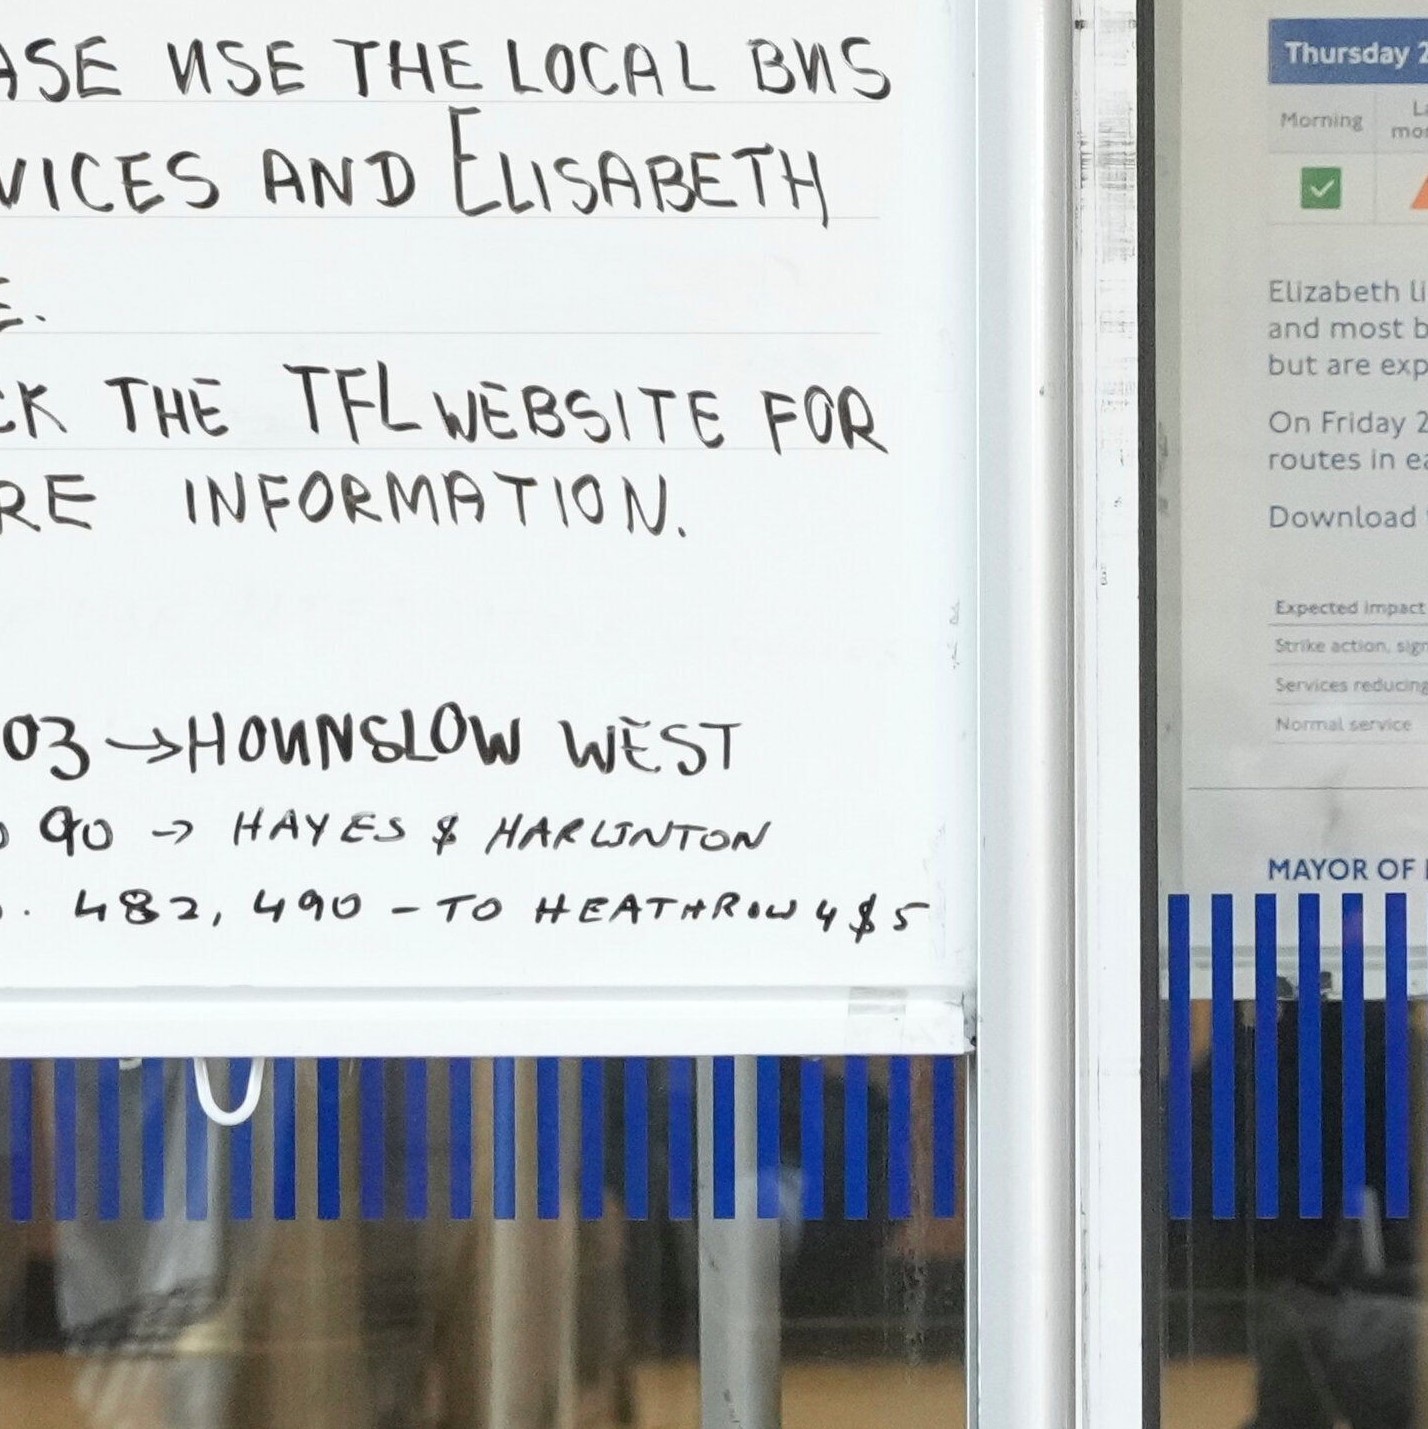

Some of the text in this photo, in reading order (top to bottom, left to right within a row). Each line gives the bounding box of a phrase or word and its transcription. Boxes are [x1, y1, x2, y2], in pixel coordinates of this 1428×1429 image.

[1284, 41, 1410, 69] Thursday
[167, 39, 304, 96] USE
[334, 39, 482, 97] THE
[507, 39, 715, 96] LOCAL
[749, 37, 891, 100] BUS
[1280, 111, 1364, 133] Morning
[263, 149, 415, 208] AND
[449, 106, 828, 228] ELISABETH
[1269, 279, 1399, 303] Elizabeth
[1268, 317, 1319, 339] and
[1330, 318, 1403, 339] most
[1269, 353, 1317, 376] but
[1326, 357, 1371, 377] are
[105, 377, 228, 438] THE
[433, 381, 724, 448] WEBSITE
[762, 385, 888, 455] FOR
[1269, 410, 1310, 434] On
[1322, 410, 1406, 439] Friday
[1268, 450, 1362, 472] routes
[1372, 449, 1395, 470] in
[186, 470, 685, 537] INFORMATION.
[1270, 505, 1416, 528] Download
[1274, 599, 1359, 618] Expected
[1363, 600, 1427, 618] impact
[1274, 637, 1326, 654] Strike
[1275, 676, 1349, 694] Services
[1274, 715, 1412, 733] Normal service
[189, 701, 520, 773] HOUNSLOW
[559, 716, 740, 776] WEST
[40, 806, 113, 856] 90
[234, 808, 405, 846] HAYES
[1269, 858, 1368, 881] MAYOR
[1377, 858, 1415, 881] OF
[75, 889, 221, 926] 482,
[254, 889, 361, 922] 490
[437, 894, 502, 922] TO
[535, 892, 797, 924] HEATHROW
[816, 900, 837, 932] 4
[893, 902, 930, 931] 5
